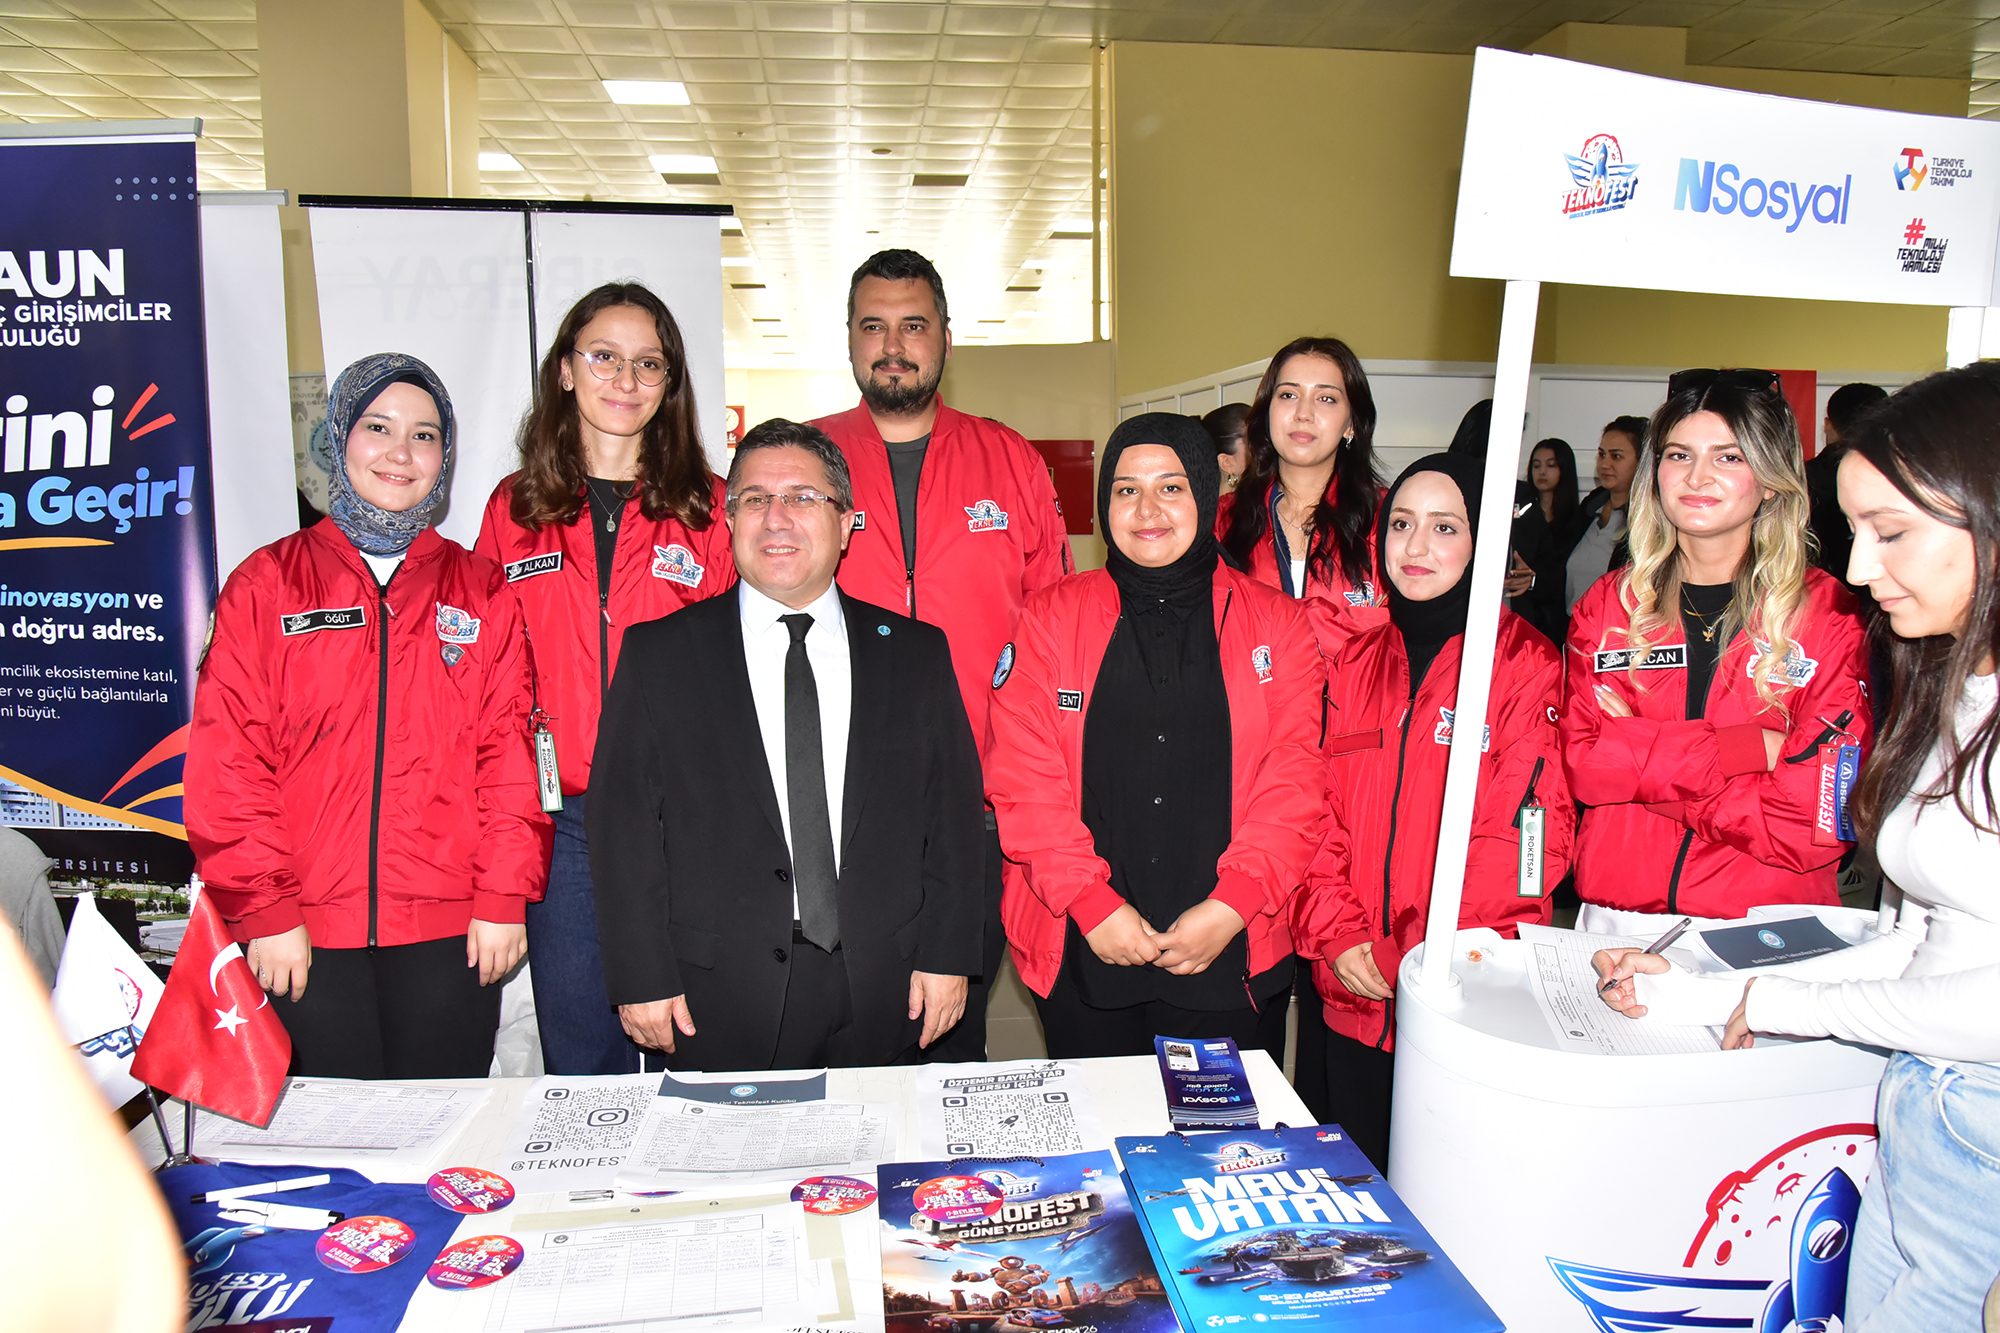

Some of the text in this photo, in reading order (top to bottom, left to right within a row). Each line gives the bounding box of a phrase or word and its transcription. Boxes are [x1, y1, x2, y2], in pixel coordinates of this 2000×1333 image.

[1562, 175, 1639, 214] TEKNOFEST
[1673, 158, 1852, 233] NSosyal
[14, 298, 172, 327] GİRİŞİMCİLER
[27, 466, 196, 535] Geçir!
[523, 556, 556, 573] ALKAN
[0, 584, 164, 614] inovasyon ve
[12, 616, 85, 645] doğru
[92, 618, 165, 642] adres.
[324, 613, 351, 625] ÖĞÜT
[45, 665, 140, 681] ekosistemine
[143, 668, 178, 685] katıl,
[16, 689, 34, 698] ve
[37, 686, 77, 702] güçlü
[81, 687, 169, 704] bağlantılarla
[17, 704, 61, 722] büyüt.
[1818, 763, 1836, 833] TEKNOFEST
[1526, 836, 1536, 879] ROKETSAN
[948, 1069, 1063, 1088] ÖZDEMİR BAYRAKTAR
[968, 1083, 1012, 1093] BURSU
[511, 1155, 627, 1172] @TEKNOFES
[1215, 1152, 1290, 1173] TEKNOFEST
[958, 1215, 1069, 1240] GÜNEYDOĞU
[1172, 1191, 1392, 1242] VATAN
